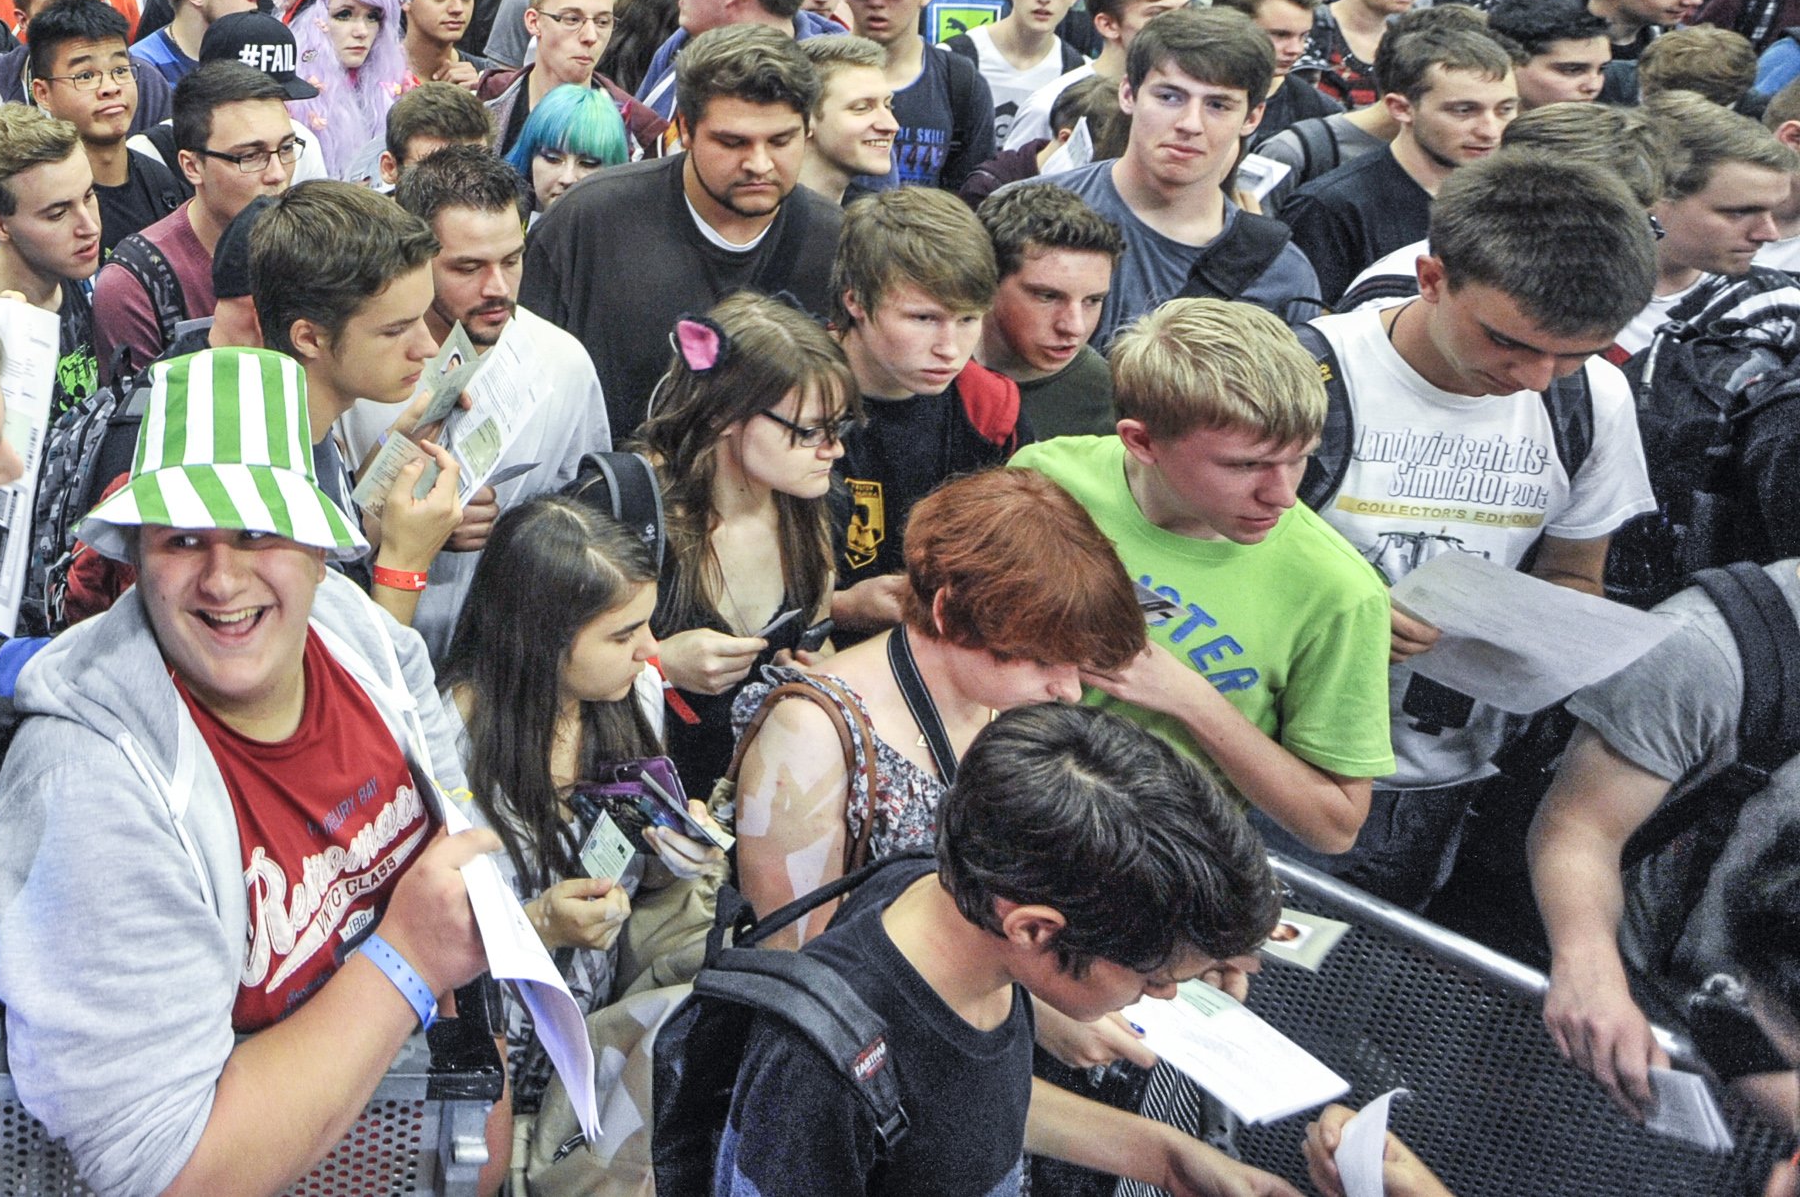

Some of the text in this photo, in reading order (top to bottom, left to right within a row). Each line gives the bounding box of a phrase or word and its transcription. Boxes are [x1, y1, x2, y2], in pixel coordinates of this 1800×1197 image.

[238, 43, 295, 72] #FAIL
[1388, 459, 1509, 506] Simulator
[1357, 501, 1467, 520] COLLECTOR'S
[346, 855, 398, 897] CLASS
